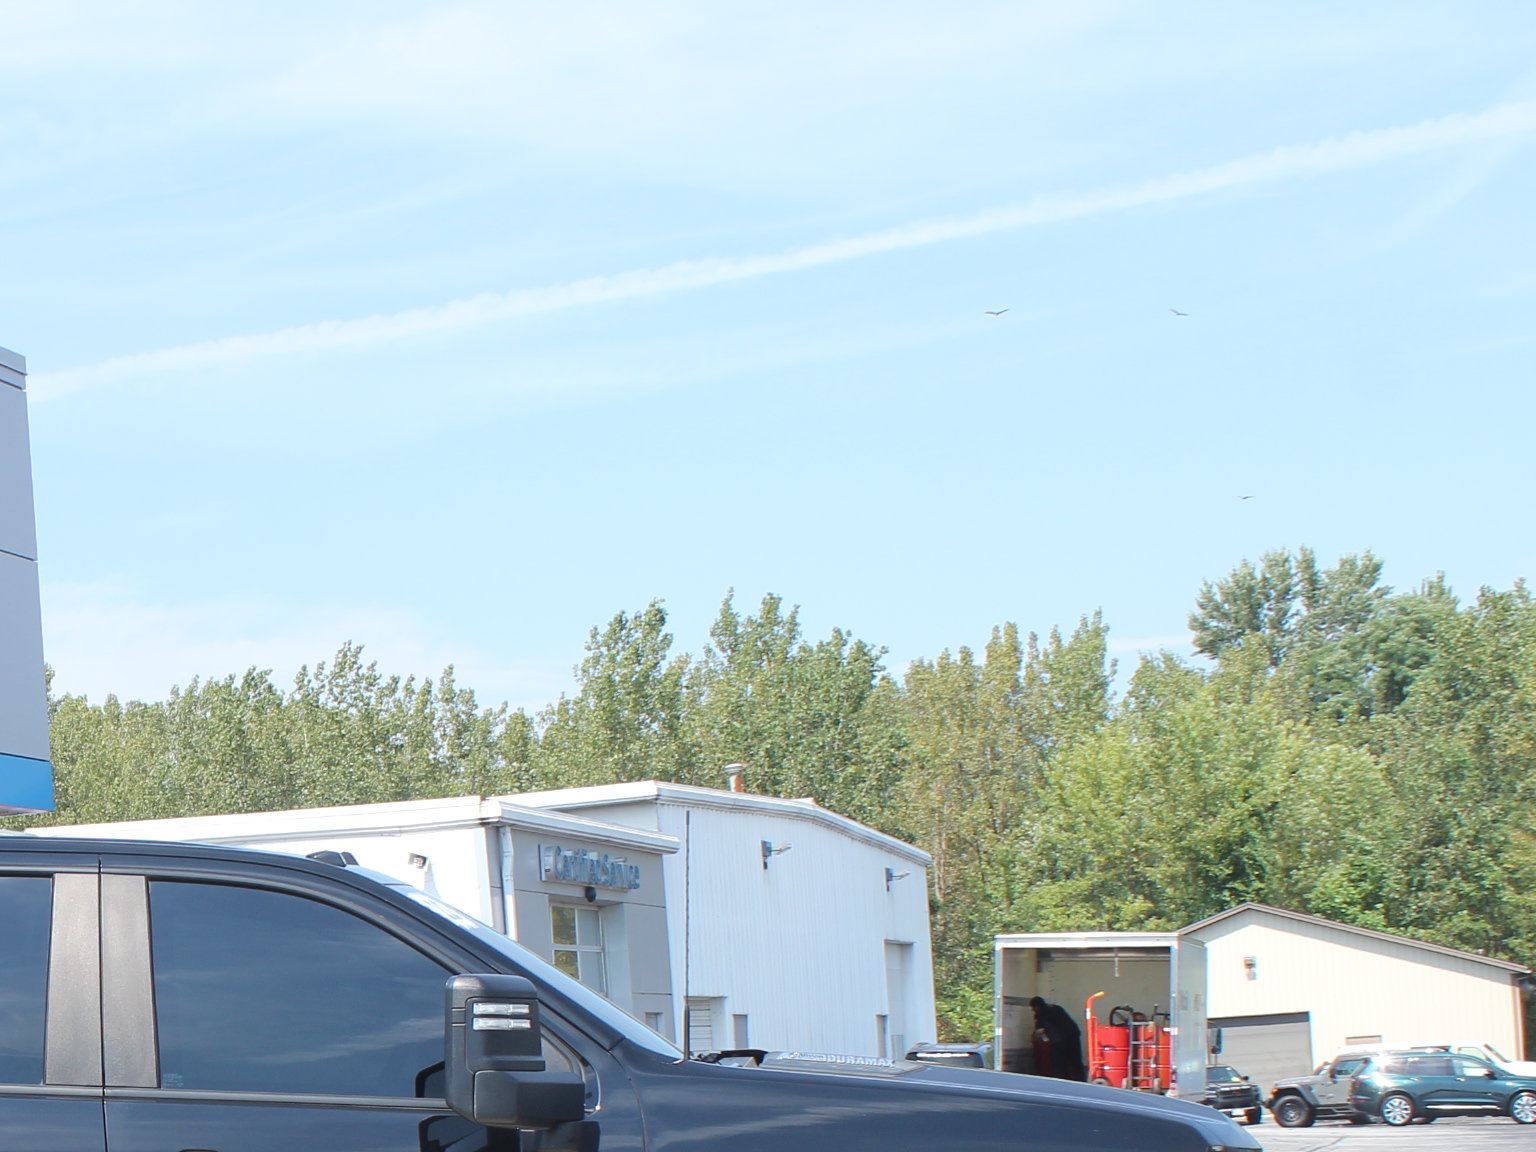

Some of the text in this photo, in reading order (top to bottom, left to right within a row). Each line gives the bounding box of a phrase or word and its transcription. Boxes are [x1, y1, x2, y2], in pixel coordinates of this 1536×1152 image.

[556, 846, 640, 889] Certified Service
[827, 1054, 895, 1067] DURAMAX
